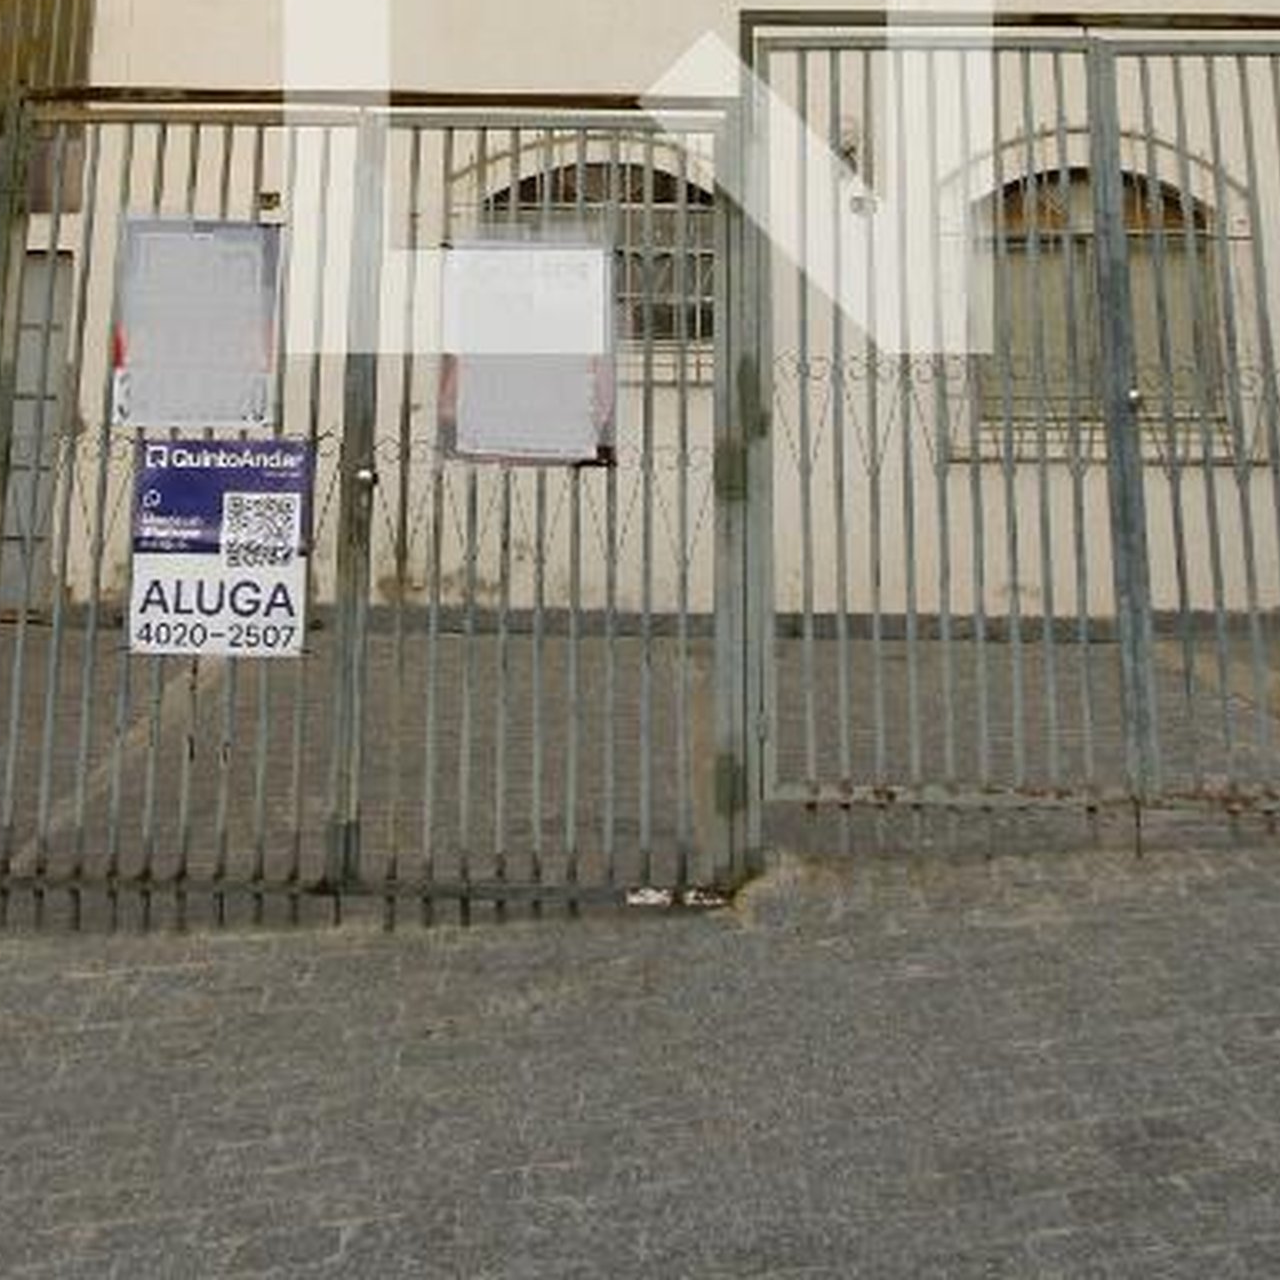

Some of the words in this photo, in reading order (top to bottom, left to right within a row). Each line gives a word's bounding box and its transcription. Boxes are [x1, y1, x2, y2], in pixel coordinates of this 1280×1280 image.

[171, 448, 303, 468] QuintoAndar
[139, 580, 294, 617] ALUGA
[136, 622, 294, 648] 4020-2507
